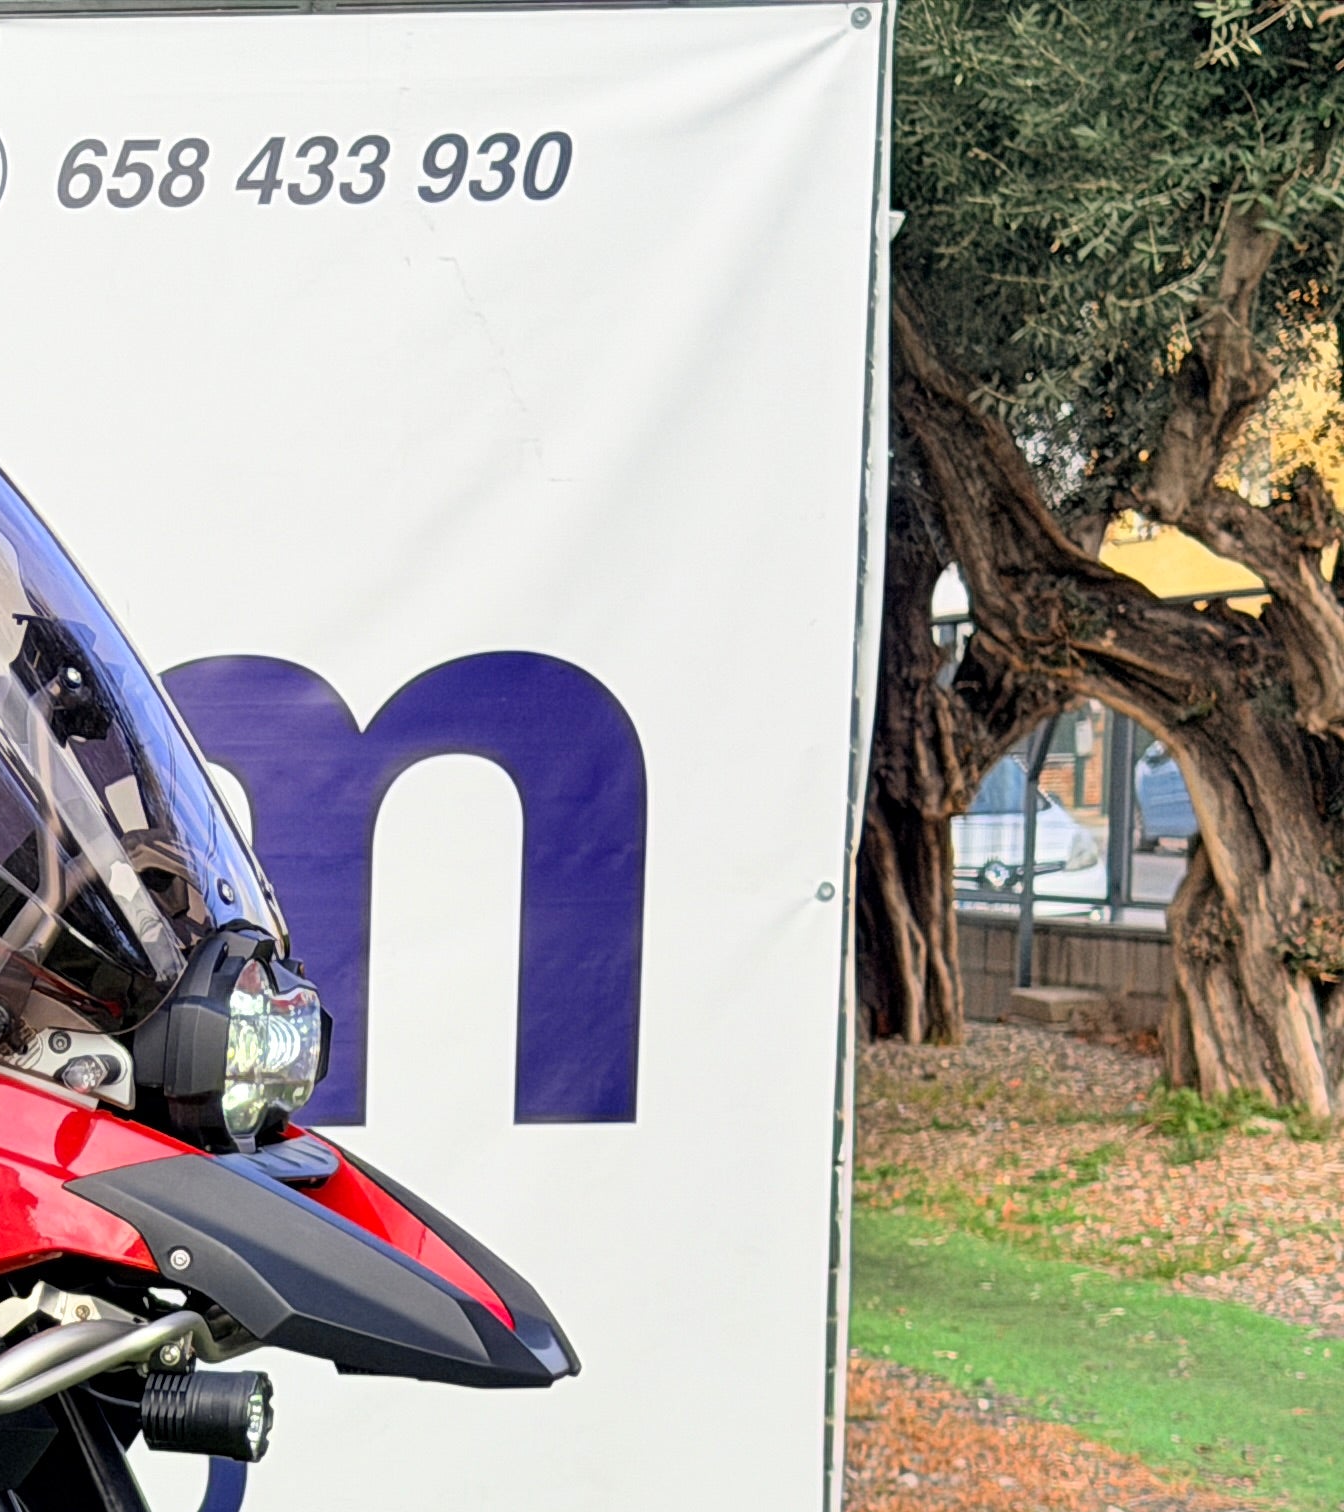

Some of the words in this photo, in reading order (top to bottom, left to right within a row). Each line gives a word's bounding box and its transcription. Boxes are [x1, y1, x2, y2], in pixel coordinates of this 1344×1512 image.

[56, 138, 210, 209] 658
[235, 134, 391, 205] 433
[417, 130, 574, 204] 930
